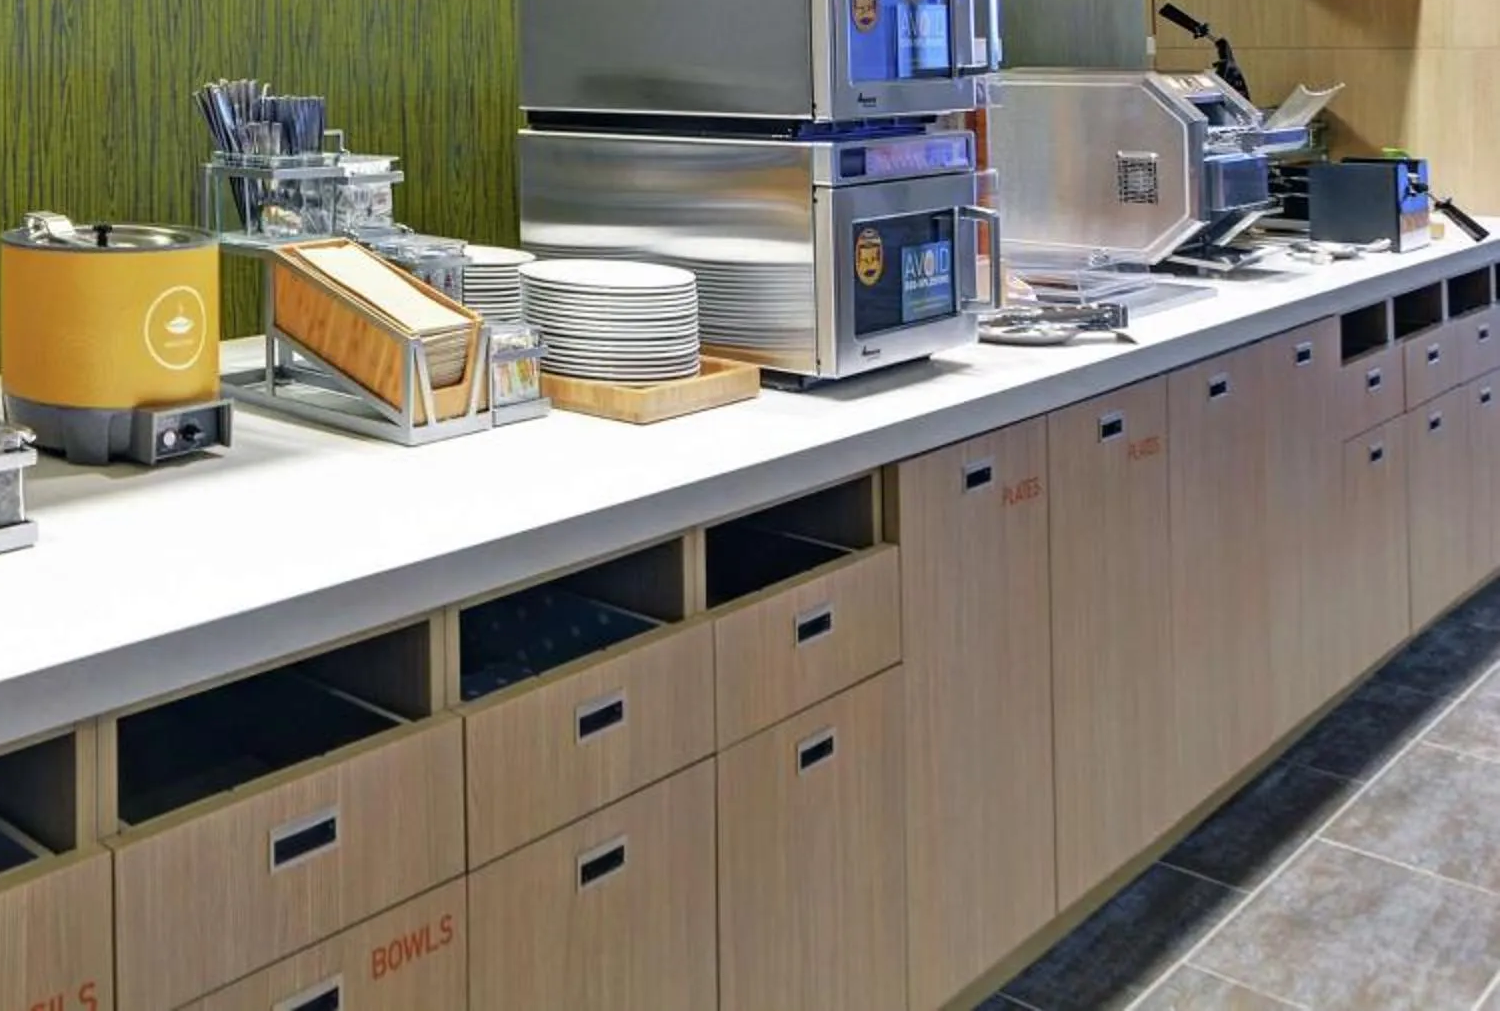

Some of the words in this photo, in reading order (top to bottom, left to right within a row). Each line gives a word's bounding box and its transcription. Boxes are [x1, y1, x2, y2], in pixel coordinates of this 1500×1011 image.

[904, 247, 949, 278] AVOID
[1002, 476, 1042, 507] PLATES
[372, 914, 453, 981] BOWLS
